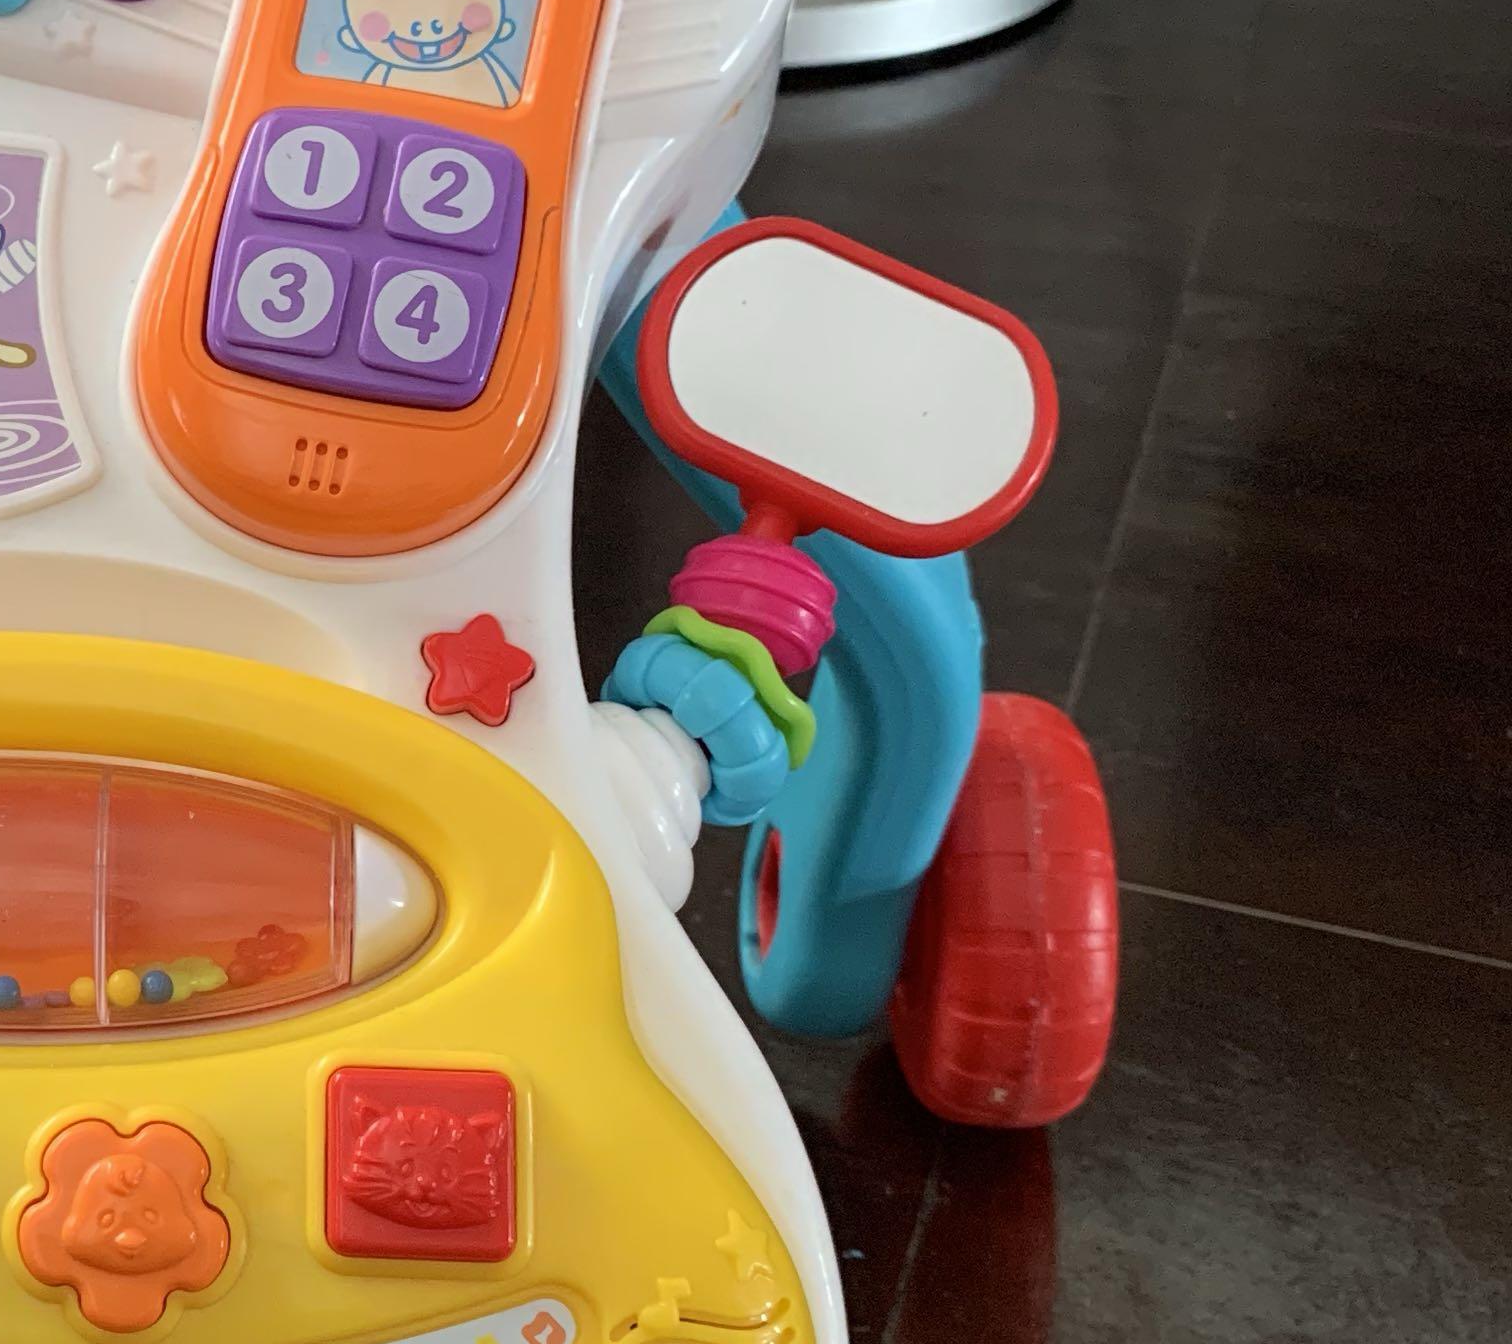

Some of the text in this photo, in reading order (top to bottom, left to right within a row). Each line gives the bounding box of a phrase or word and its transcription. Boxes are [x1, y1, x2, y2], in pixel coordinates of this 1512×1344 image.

[301, 140, 325, 196] 1
[423, 161, 469, 218] 2
[261, 262, 307, 323] 3
[395, 285, 440, 344] 4
